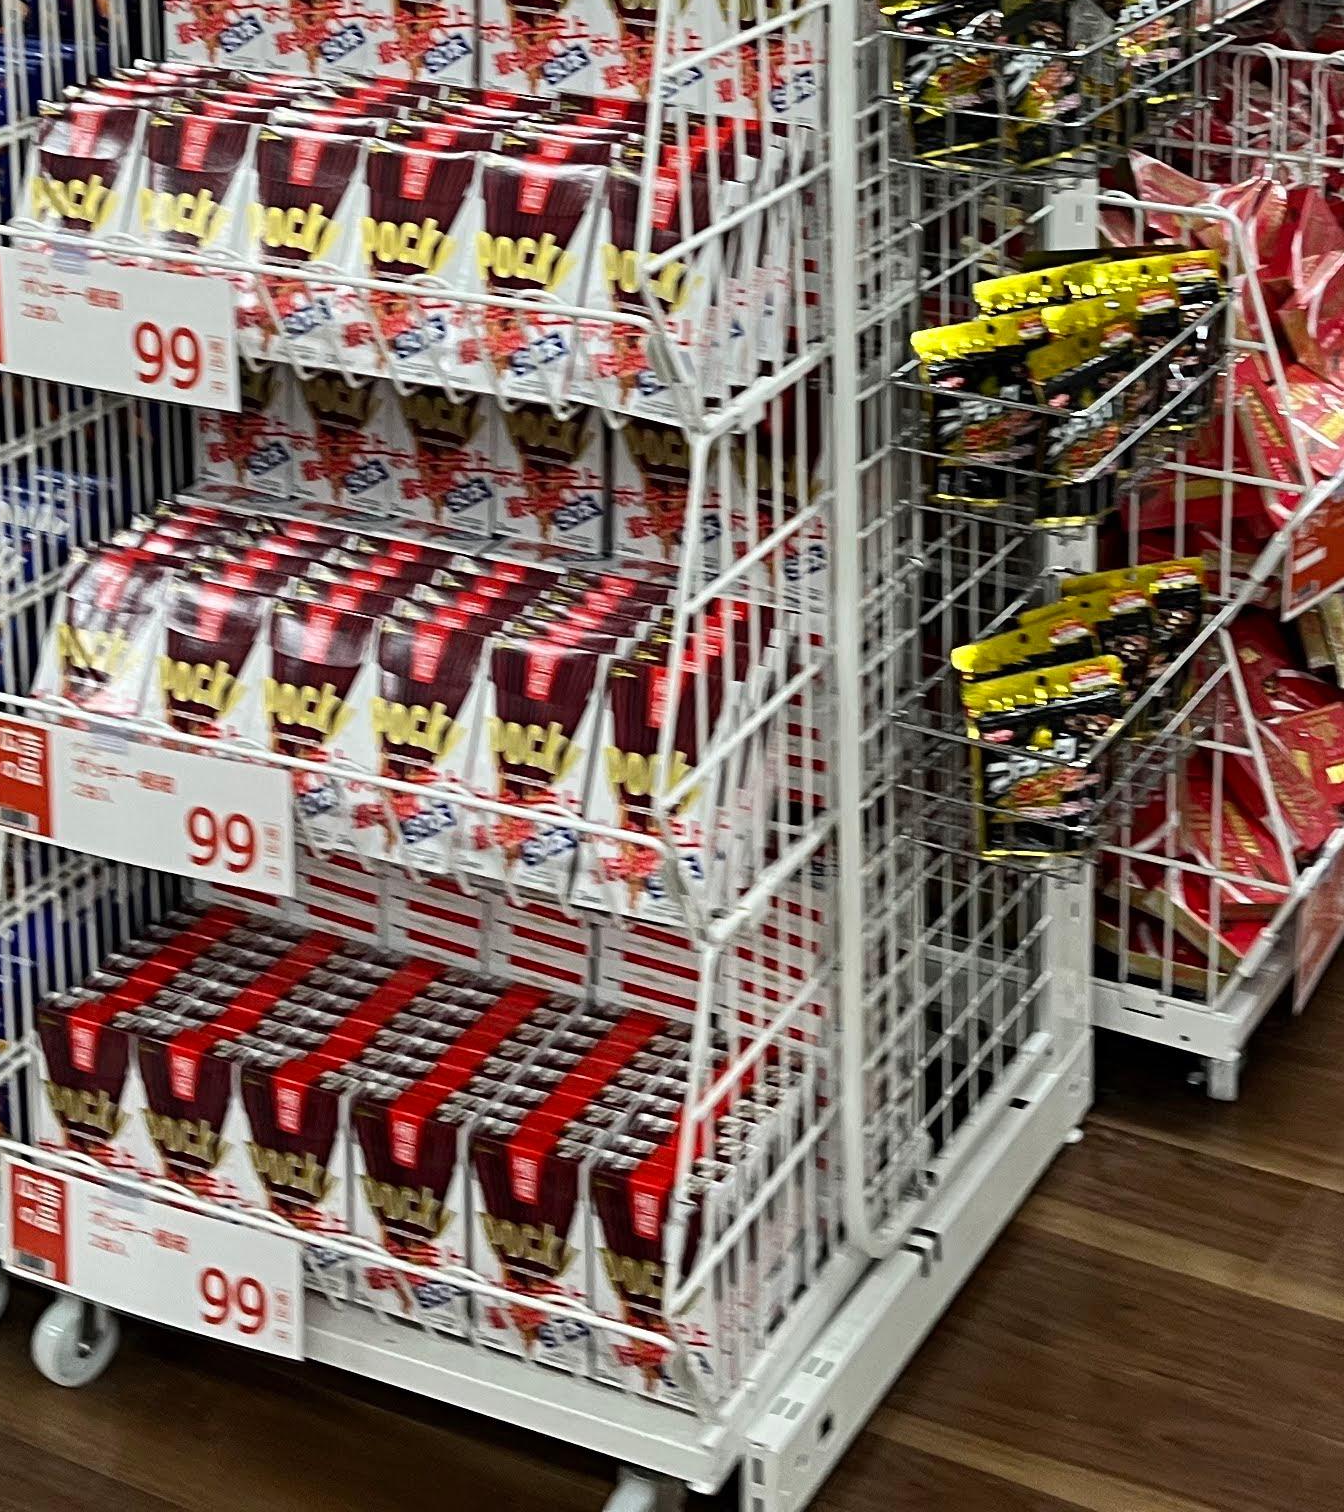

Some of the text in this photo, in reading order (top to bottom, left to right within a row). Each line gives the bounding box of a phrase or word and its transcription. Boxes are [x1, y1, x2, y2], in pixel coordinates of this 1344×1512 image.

[250, 203, 341, 262] POCKY
[362, 216, 454, 278] POCKY
[476, 230, 571, 292] POCKY
[132, 320, 202, 391] 99
[263, 677, 351, 736] POCKY
[371, 700, 464, 756] POCKY
[487, 716, 577, 780] POCKY
[185, 805, 256, 874] 99
[197, 1266, 268, 1335] 99
